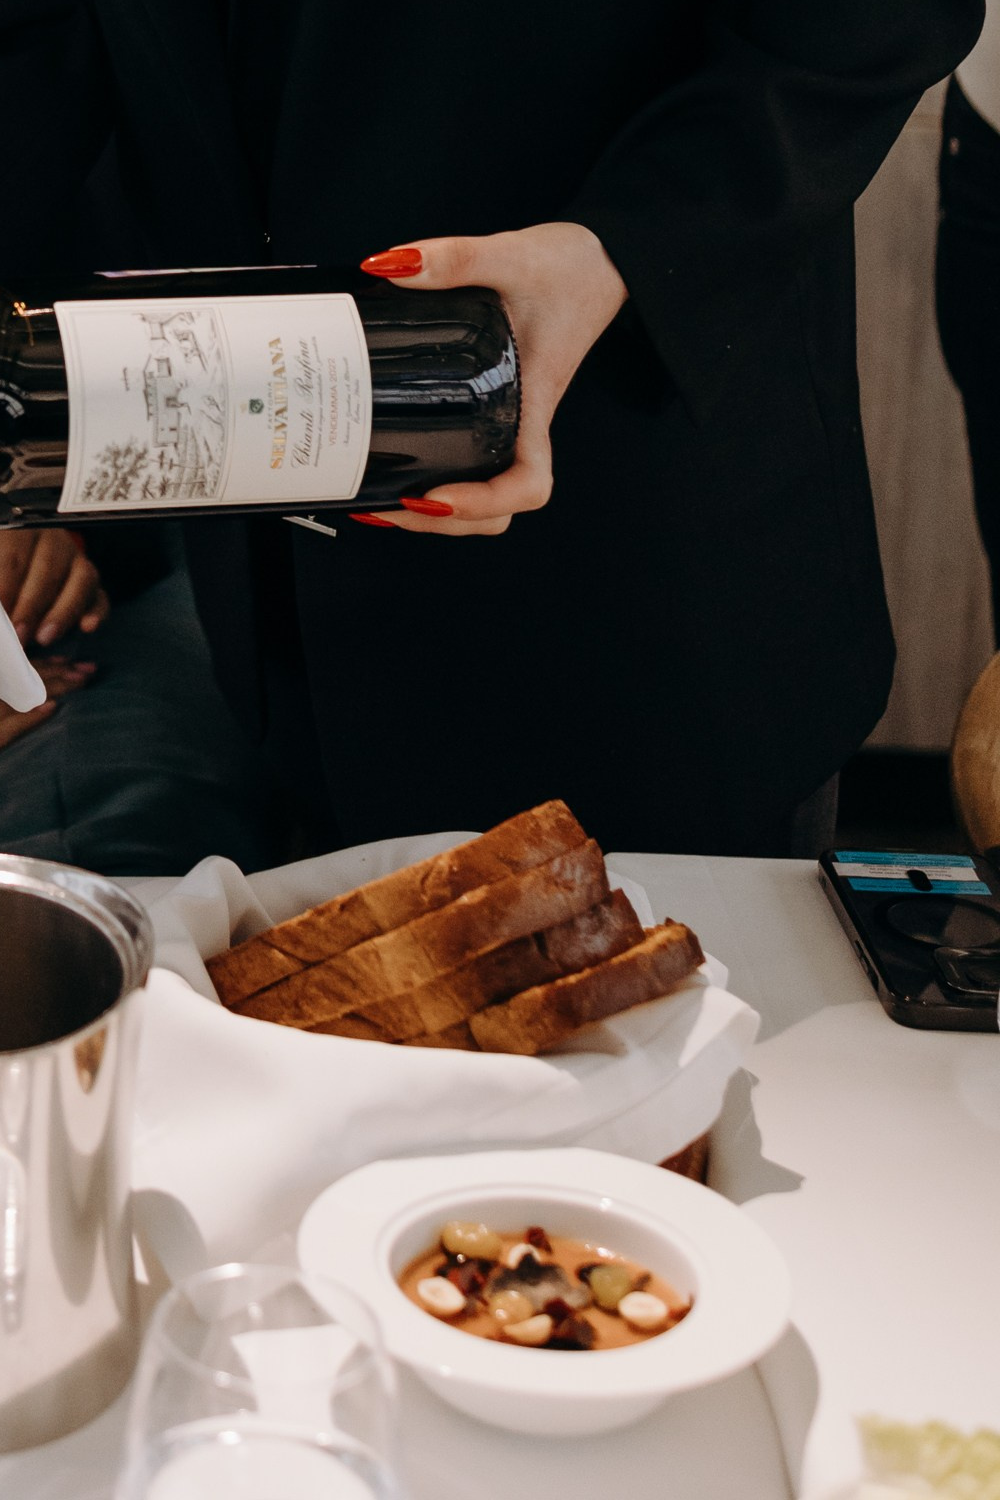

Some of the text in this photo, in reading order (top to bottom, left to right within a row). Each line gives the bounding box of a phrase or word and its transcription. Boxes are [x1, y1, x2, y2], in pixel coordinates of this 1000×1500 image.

[268, 337, 288, 469] SELVAPIANA
[291, 339, 317, 469] Chianti Rufina
[328, 357, 338, 446] VENDEMMIA 2022
